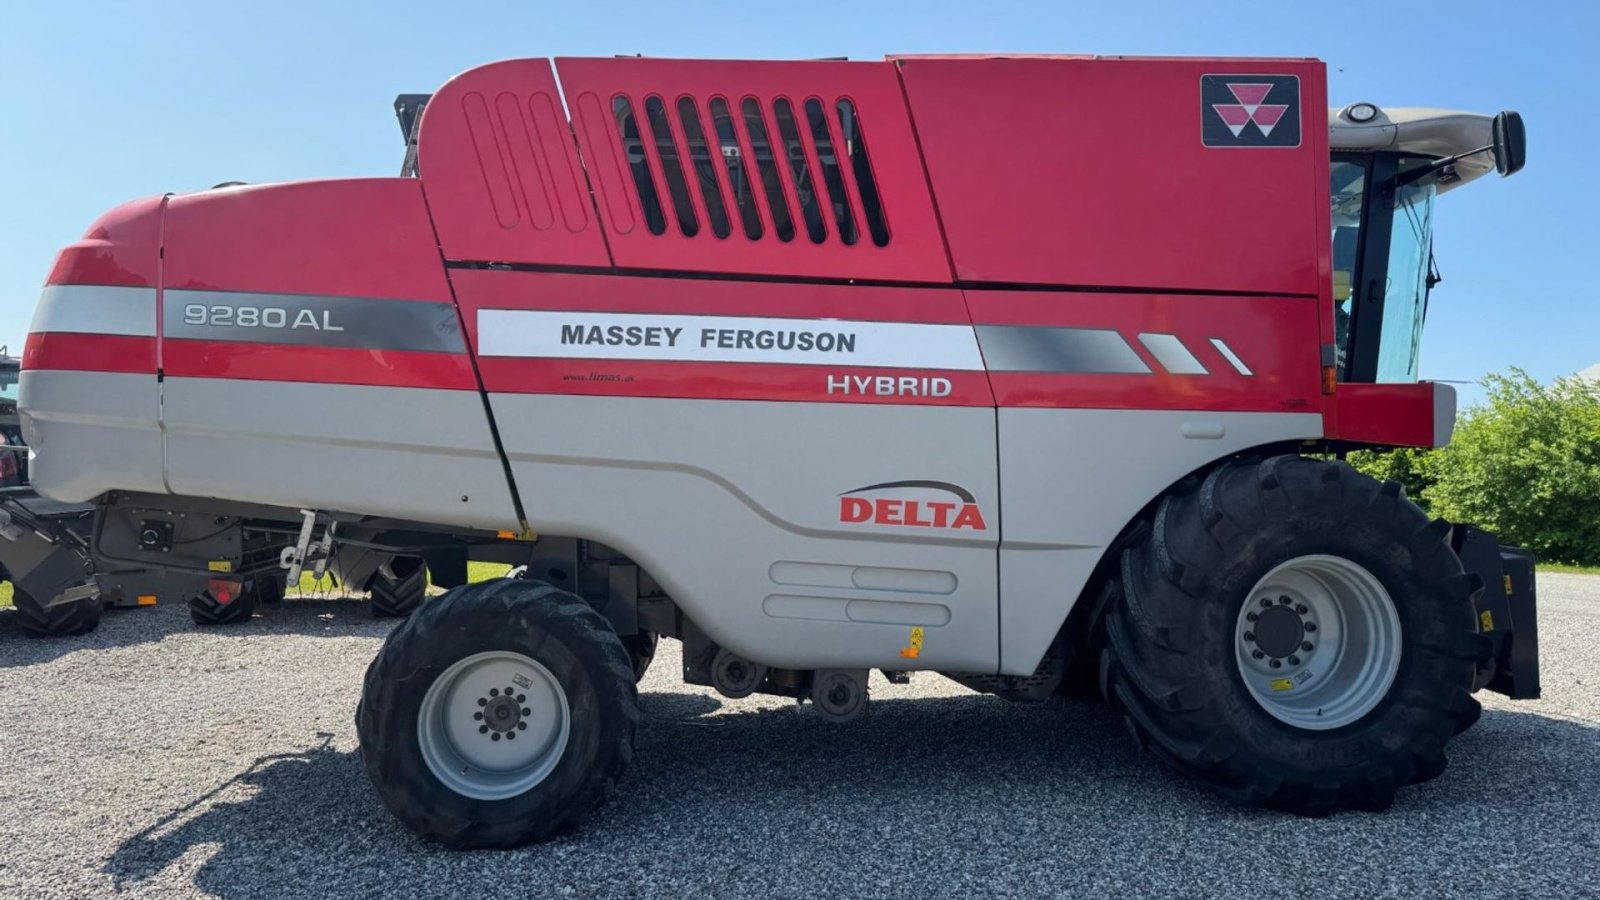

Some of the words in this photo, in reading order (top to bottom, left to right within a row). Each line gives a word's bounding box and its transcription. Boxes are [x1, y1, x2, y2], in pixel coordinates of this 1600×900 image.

[561, 325, 683, 347] MASSEY
[700, 328, 856, 352] FERGUSON
[826, 375, 952, 397] HYBRID
[839, 497, 987, 531] DELTA
